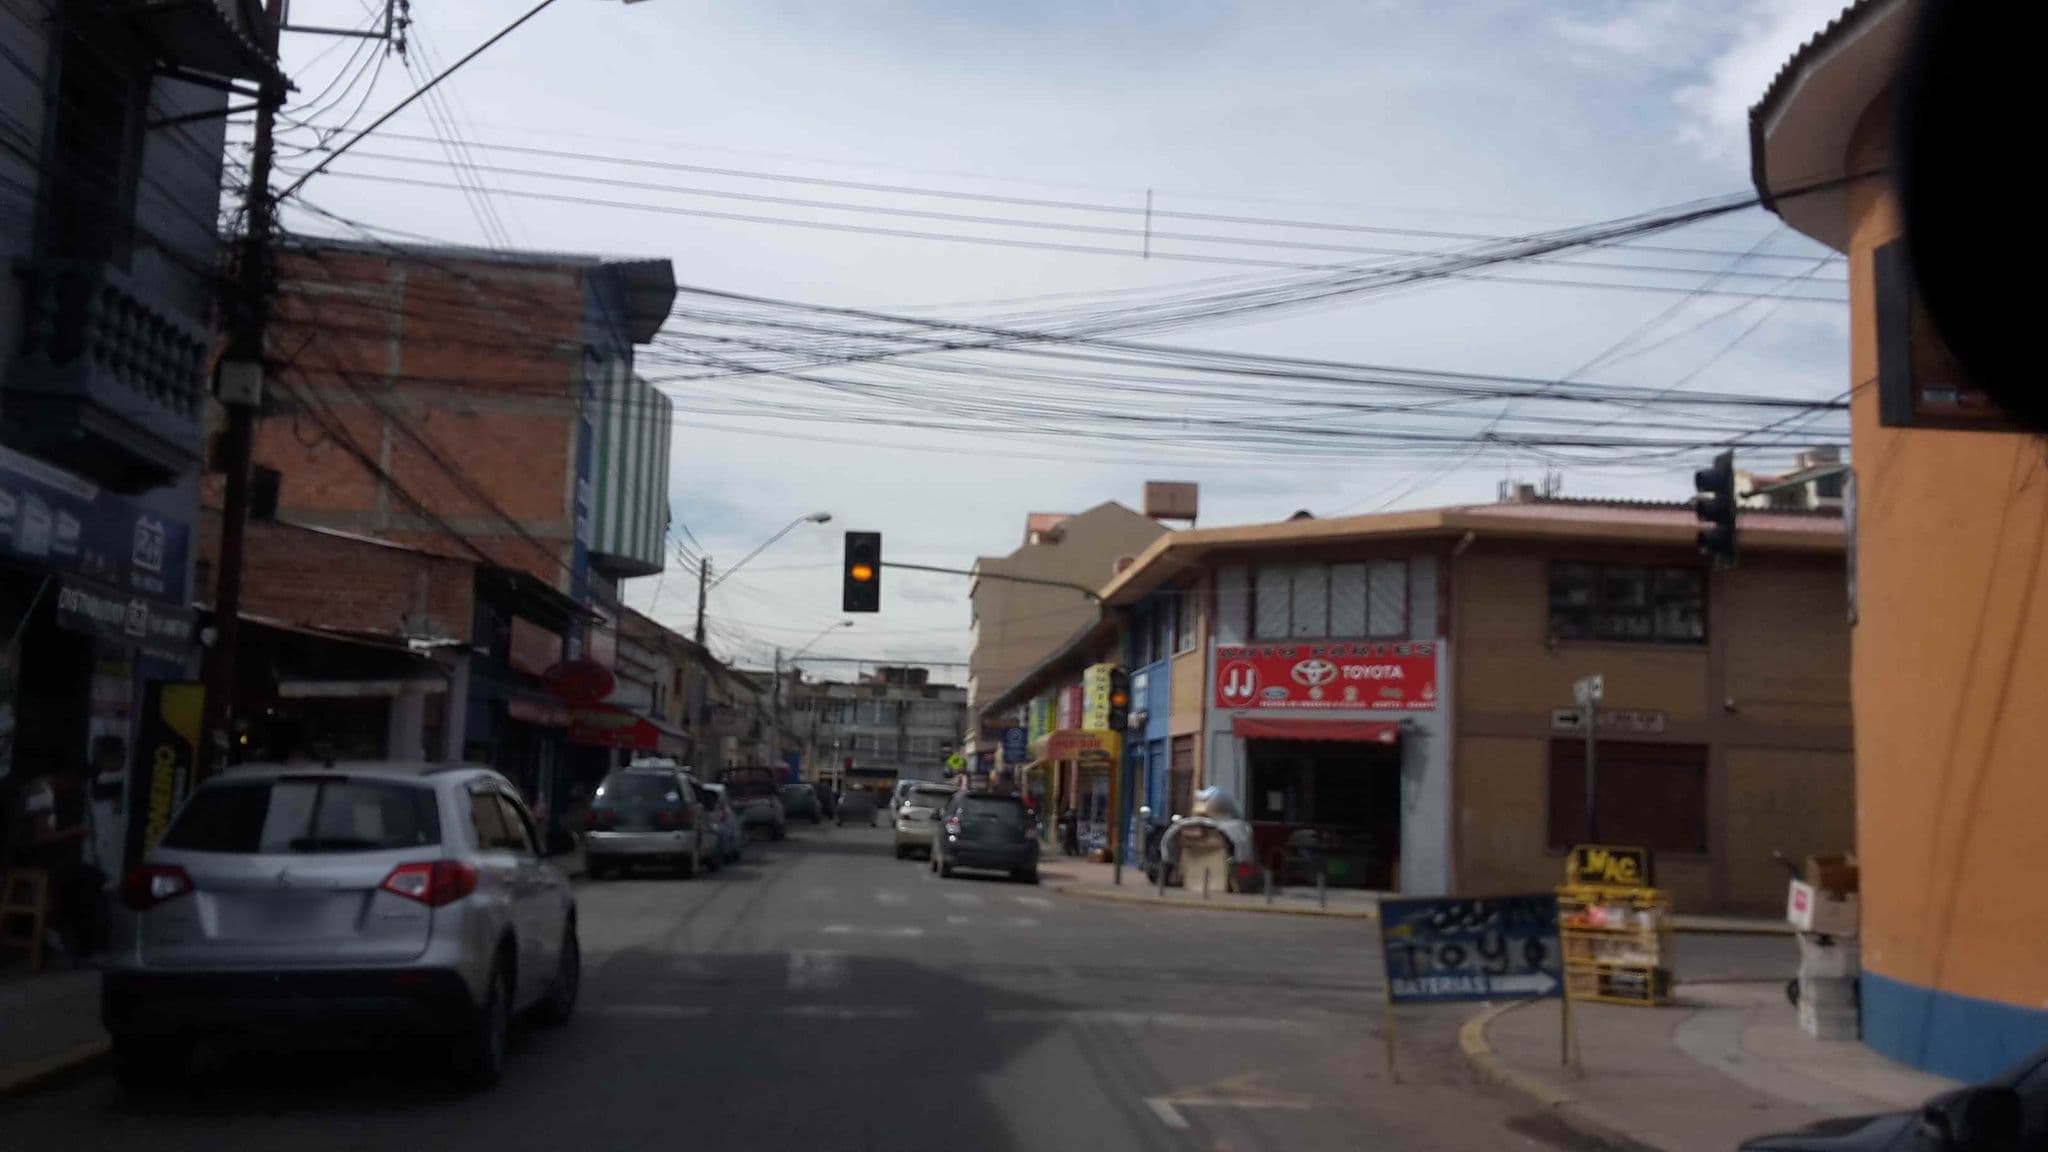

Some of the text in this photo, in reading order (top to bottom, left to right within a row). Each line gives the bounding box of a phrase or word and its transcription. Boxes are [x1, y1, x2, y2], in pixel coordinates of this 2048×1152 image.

[1311, 644, 1434, 657] PARTES
[1341, 665, 1404, 681] TOYOTA
[1223, 668, 1256, 697] JJ
[1392, 976, 1489, 997] BATERIAS
